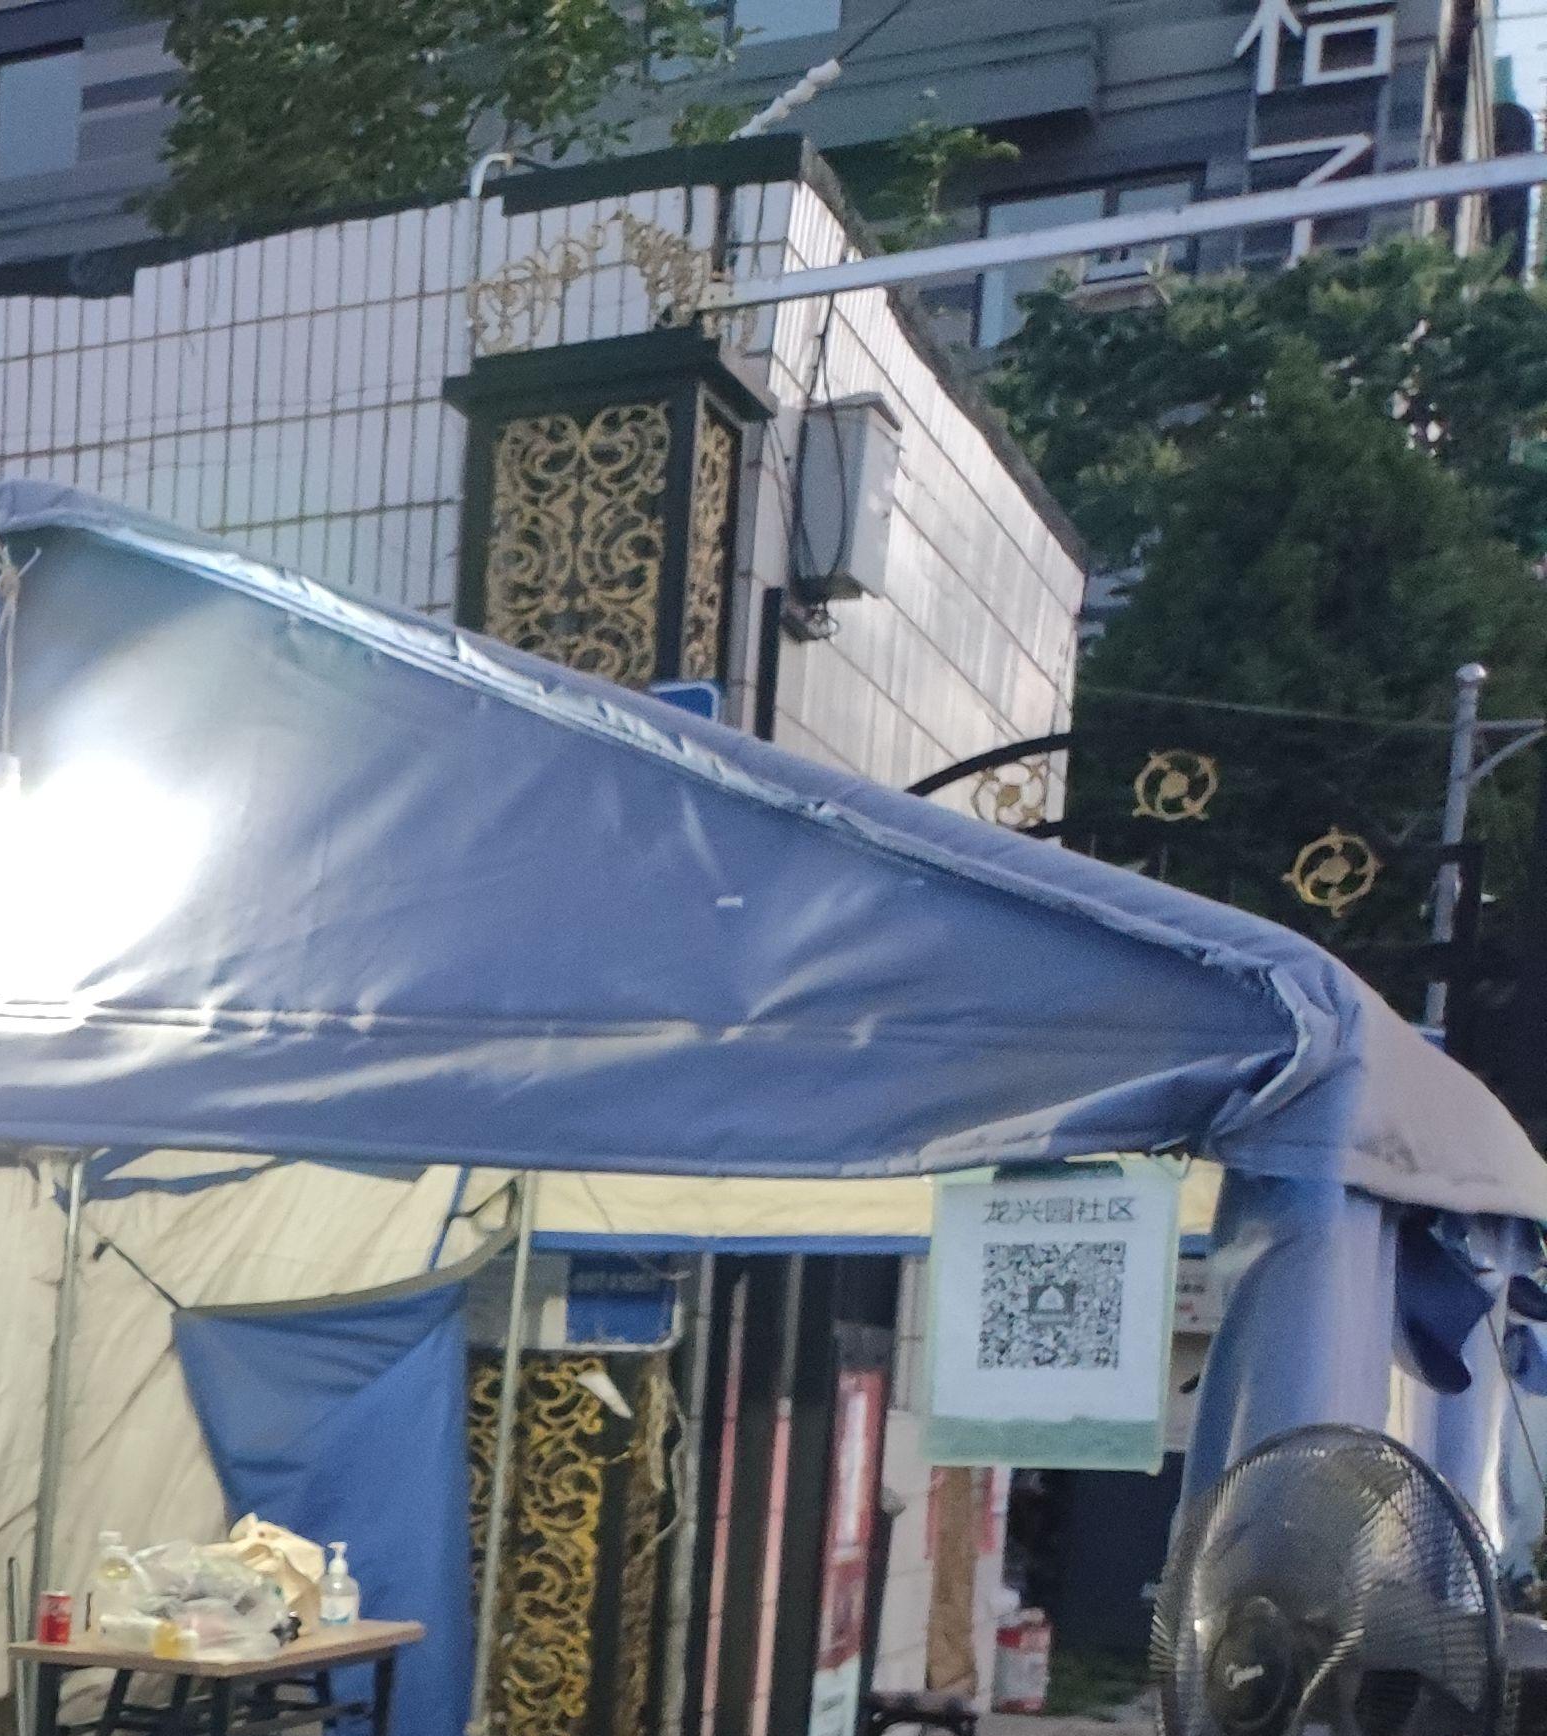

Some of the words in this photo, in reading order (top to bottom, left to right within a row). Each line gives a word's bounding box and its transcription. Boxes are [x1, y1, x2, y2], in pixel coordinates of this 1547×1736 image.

[984, 1197, 1135, 1224] 龙兴园社区
